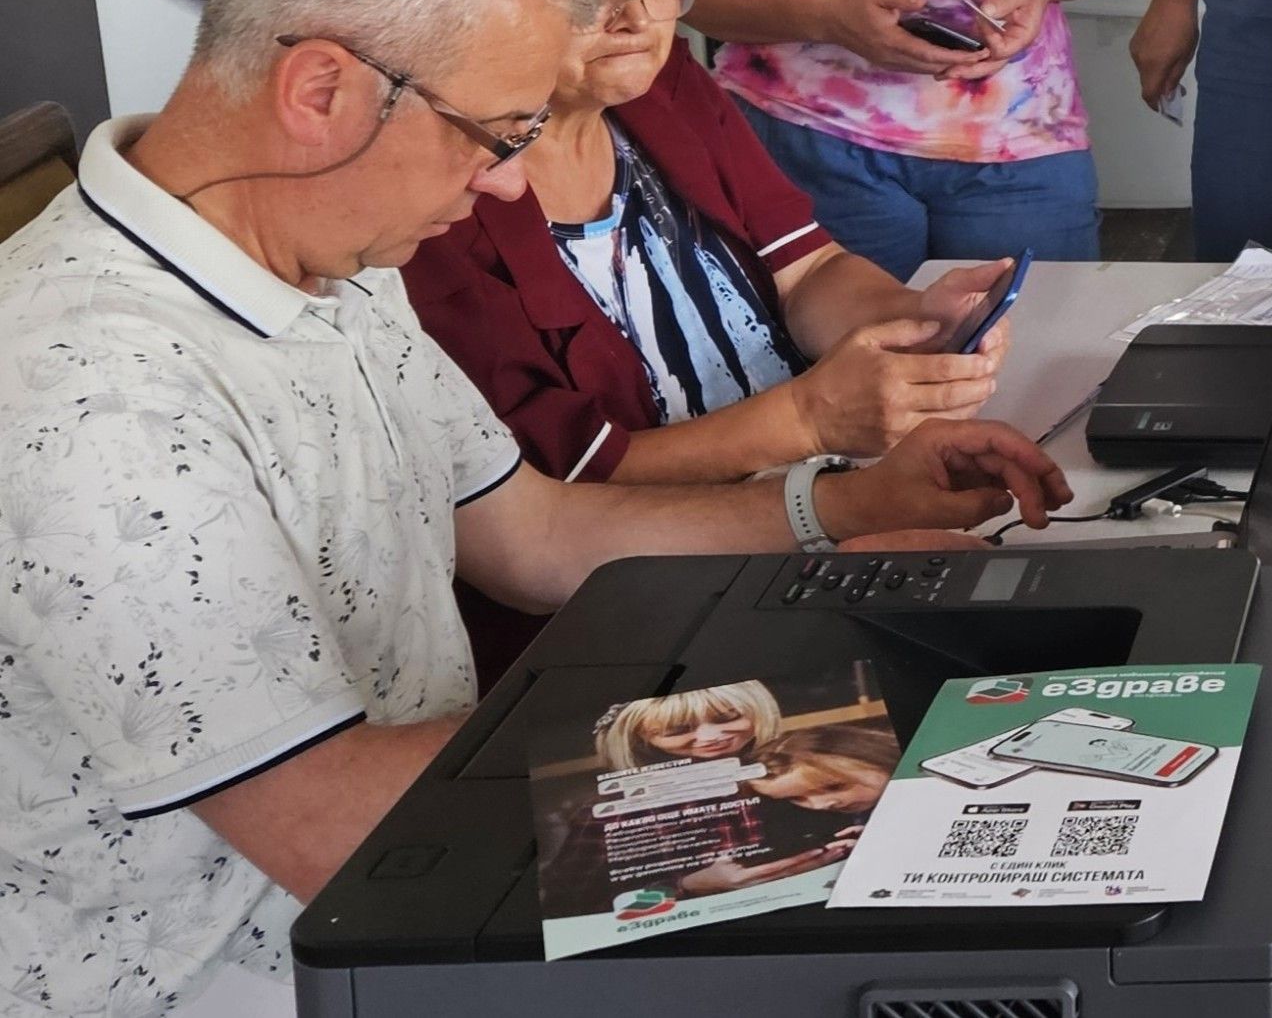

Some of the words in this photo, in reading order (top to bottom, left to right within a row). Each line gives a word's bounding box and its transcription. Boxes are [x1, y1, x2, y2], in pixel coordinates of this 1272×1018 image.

[1042, 675, 1225, 698] еЗдраве
[1000, 861, 1032, 870] ЕДИН
[1035, 860, 1068, 869] КЛИК
[903, 872, 923, 883] ТИ
[926, 871, 1049, 883] КОНТРОЛИРАШ
[1050, 870, 1145, 882] СИСТЕМАТА
